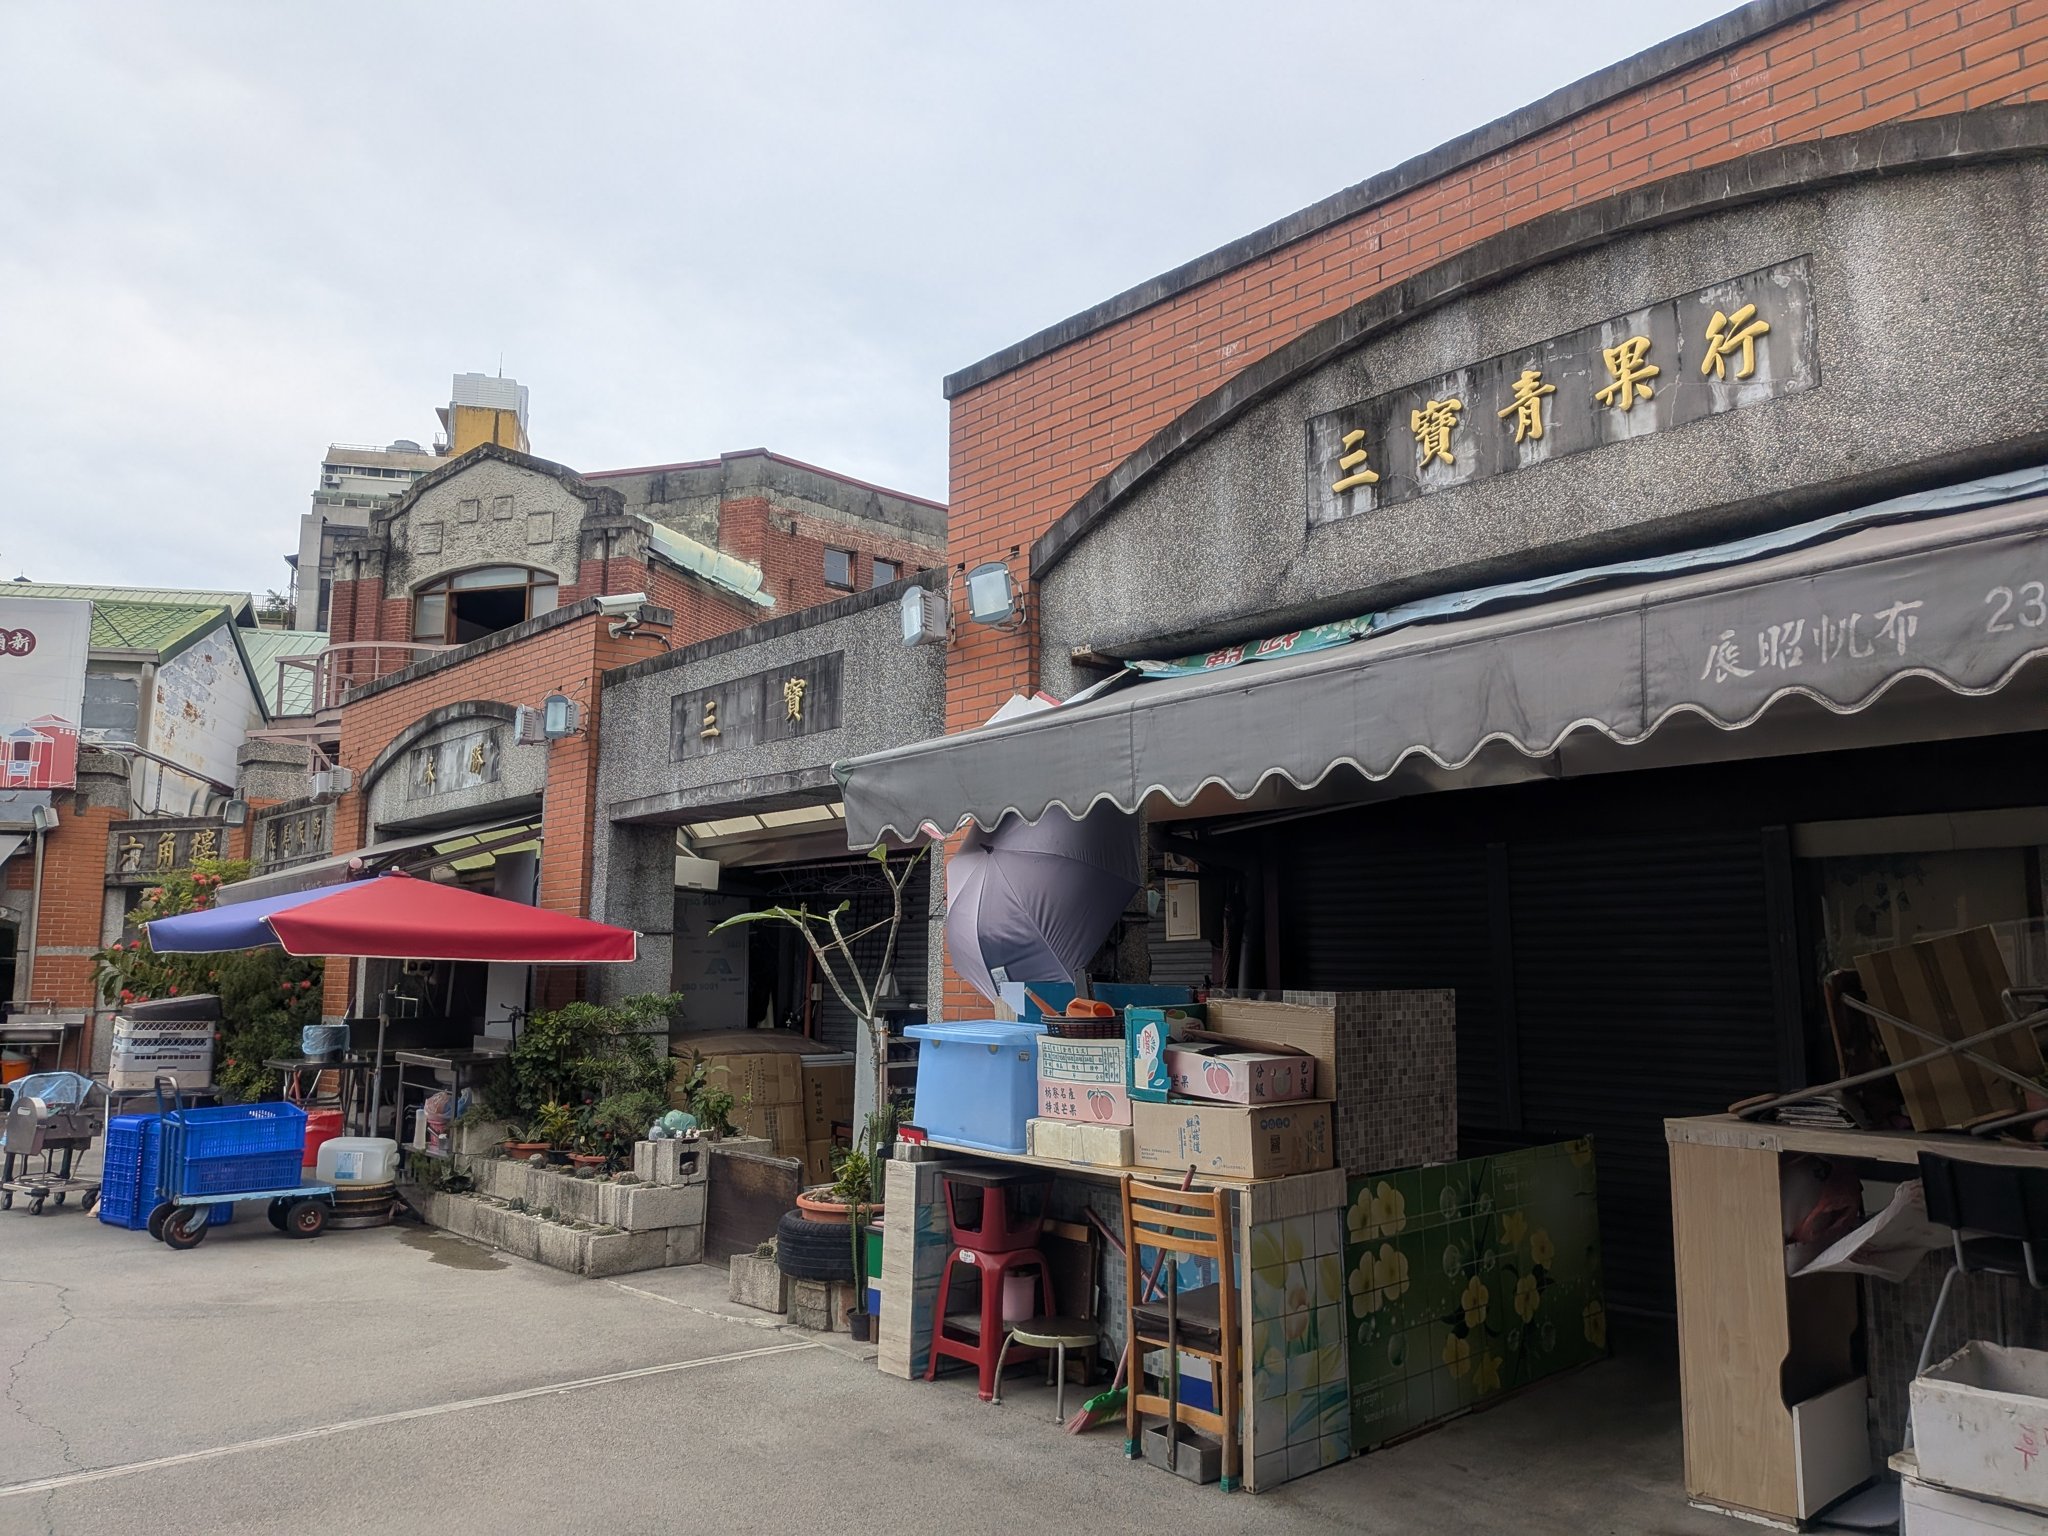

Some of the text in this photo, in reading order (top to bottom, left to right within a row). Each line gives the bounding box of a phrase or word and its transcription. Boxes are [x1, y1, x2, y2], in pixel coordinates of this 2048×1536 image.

[1332, 303, 1770, 494] 三寶青果行
[1701, 600, 1924, 684] 展昭帆布
[700, 675, 807, 739] 三寶
[117, 827, 220, 873] 六角樓
